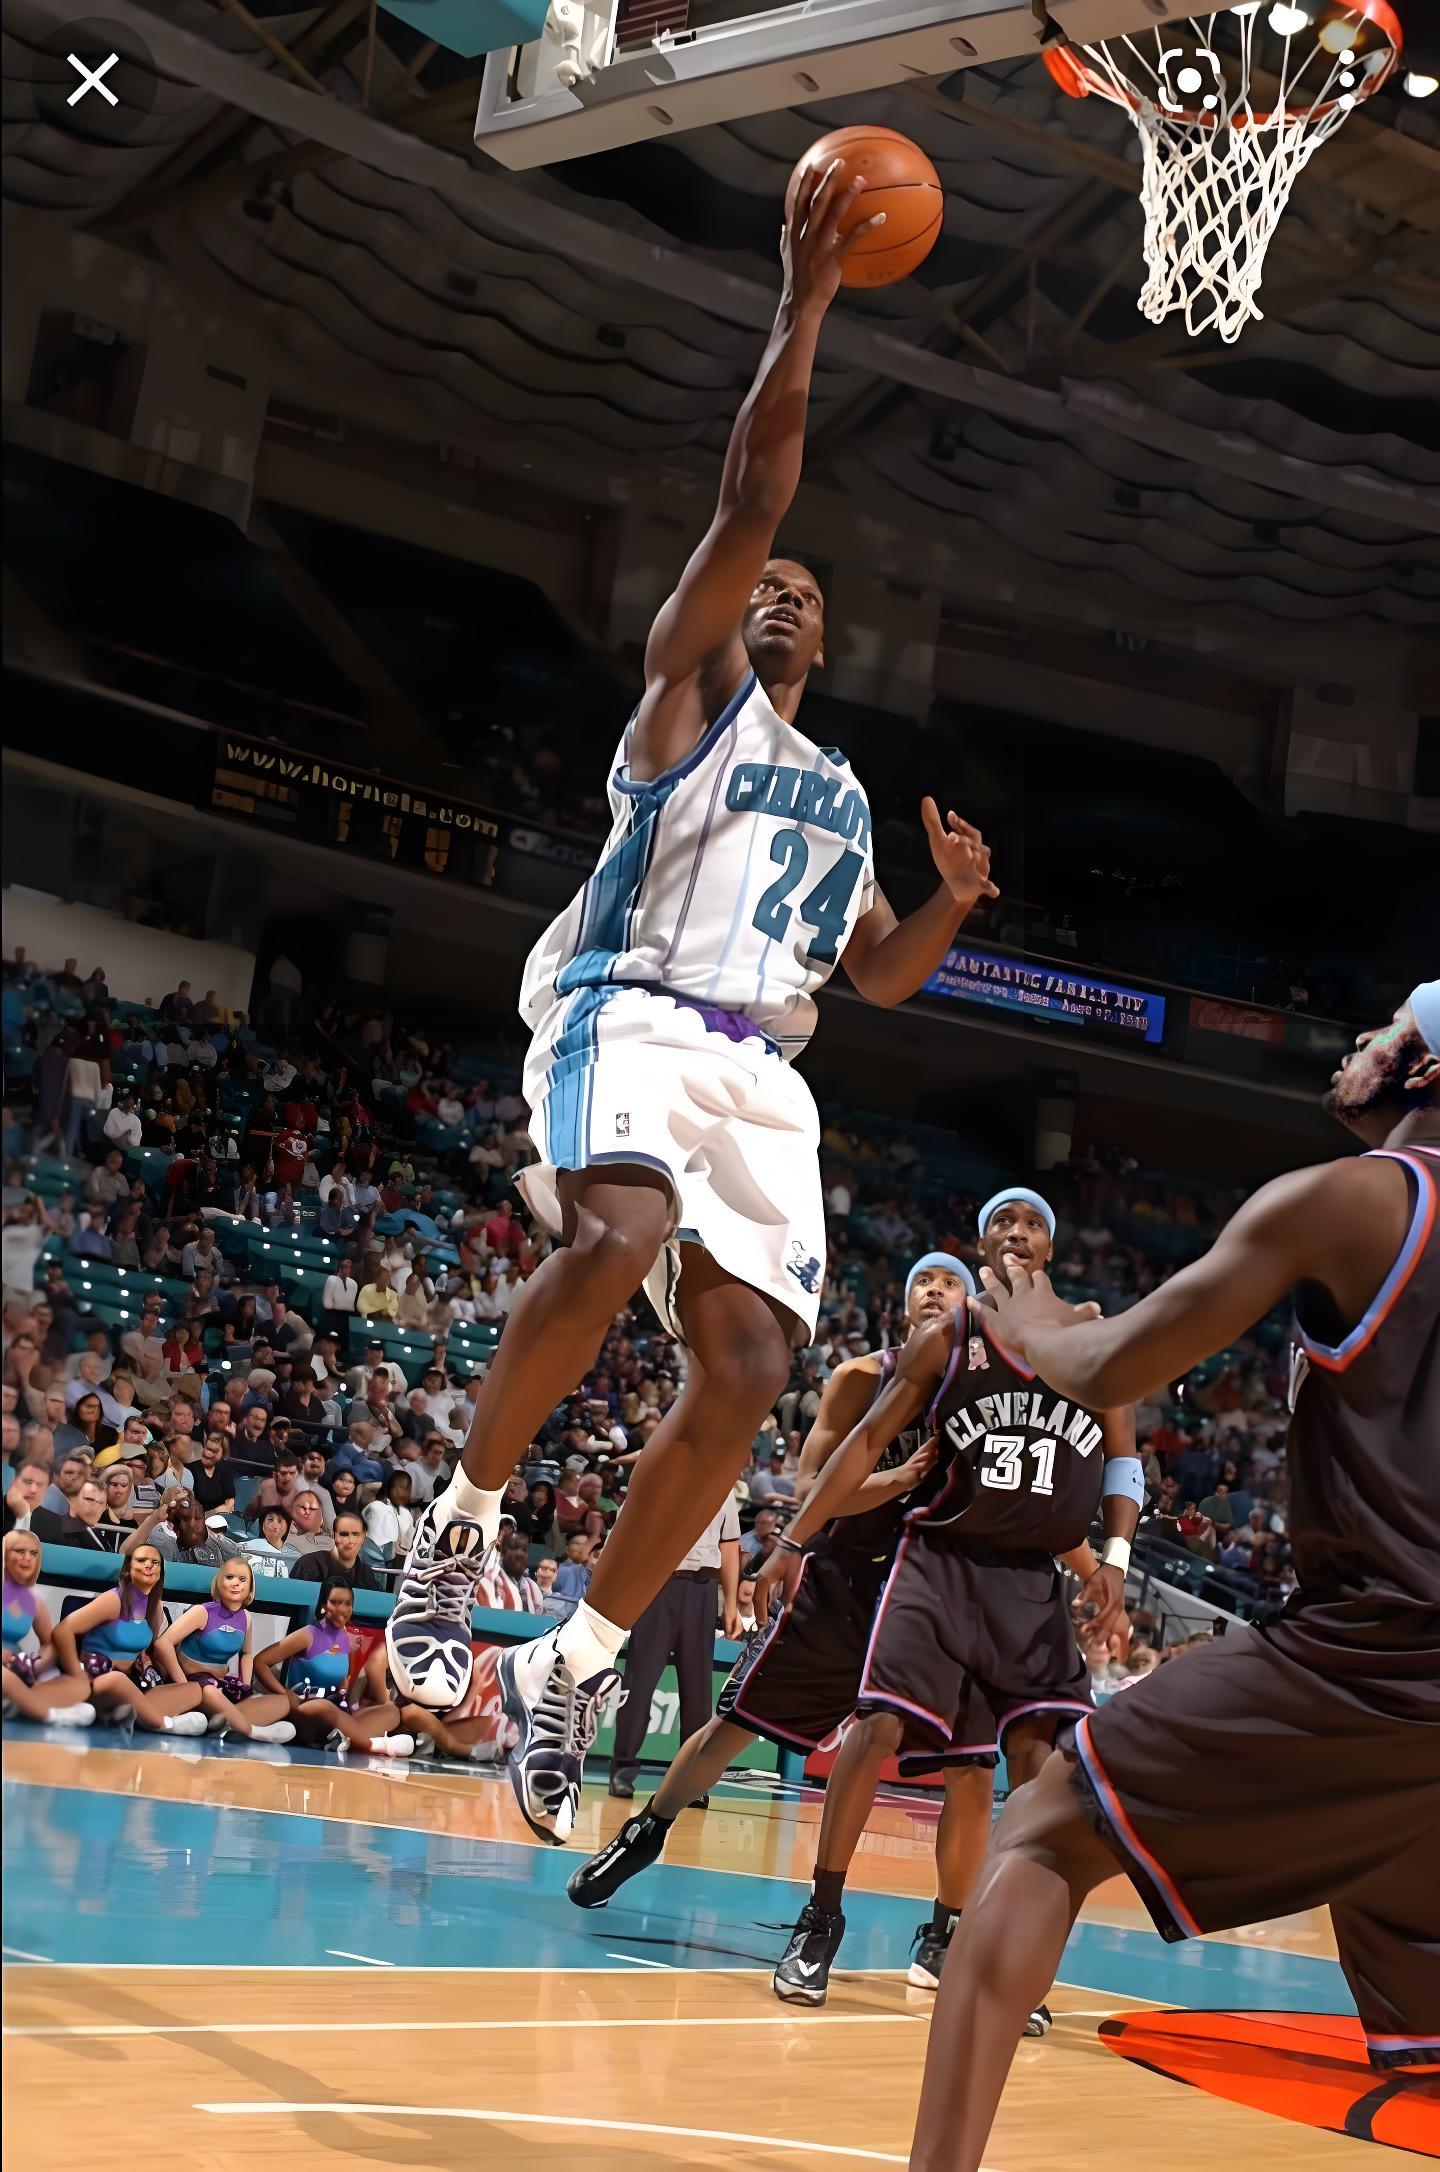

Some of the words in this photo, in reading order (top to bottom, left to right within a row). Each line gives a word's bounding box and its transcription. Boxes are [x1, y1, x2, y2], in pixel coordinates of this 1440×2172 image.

[752, 829, 865, 965] 24
[945, 1392, 1103, 1458] CLEVELAND
[981, 1434, 1057, 1496] 31
